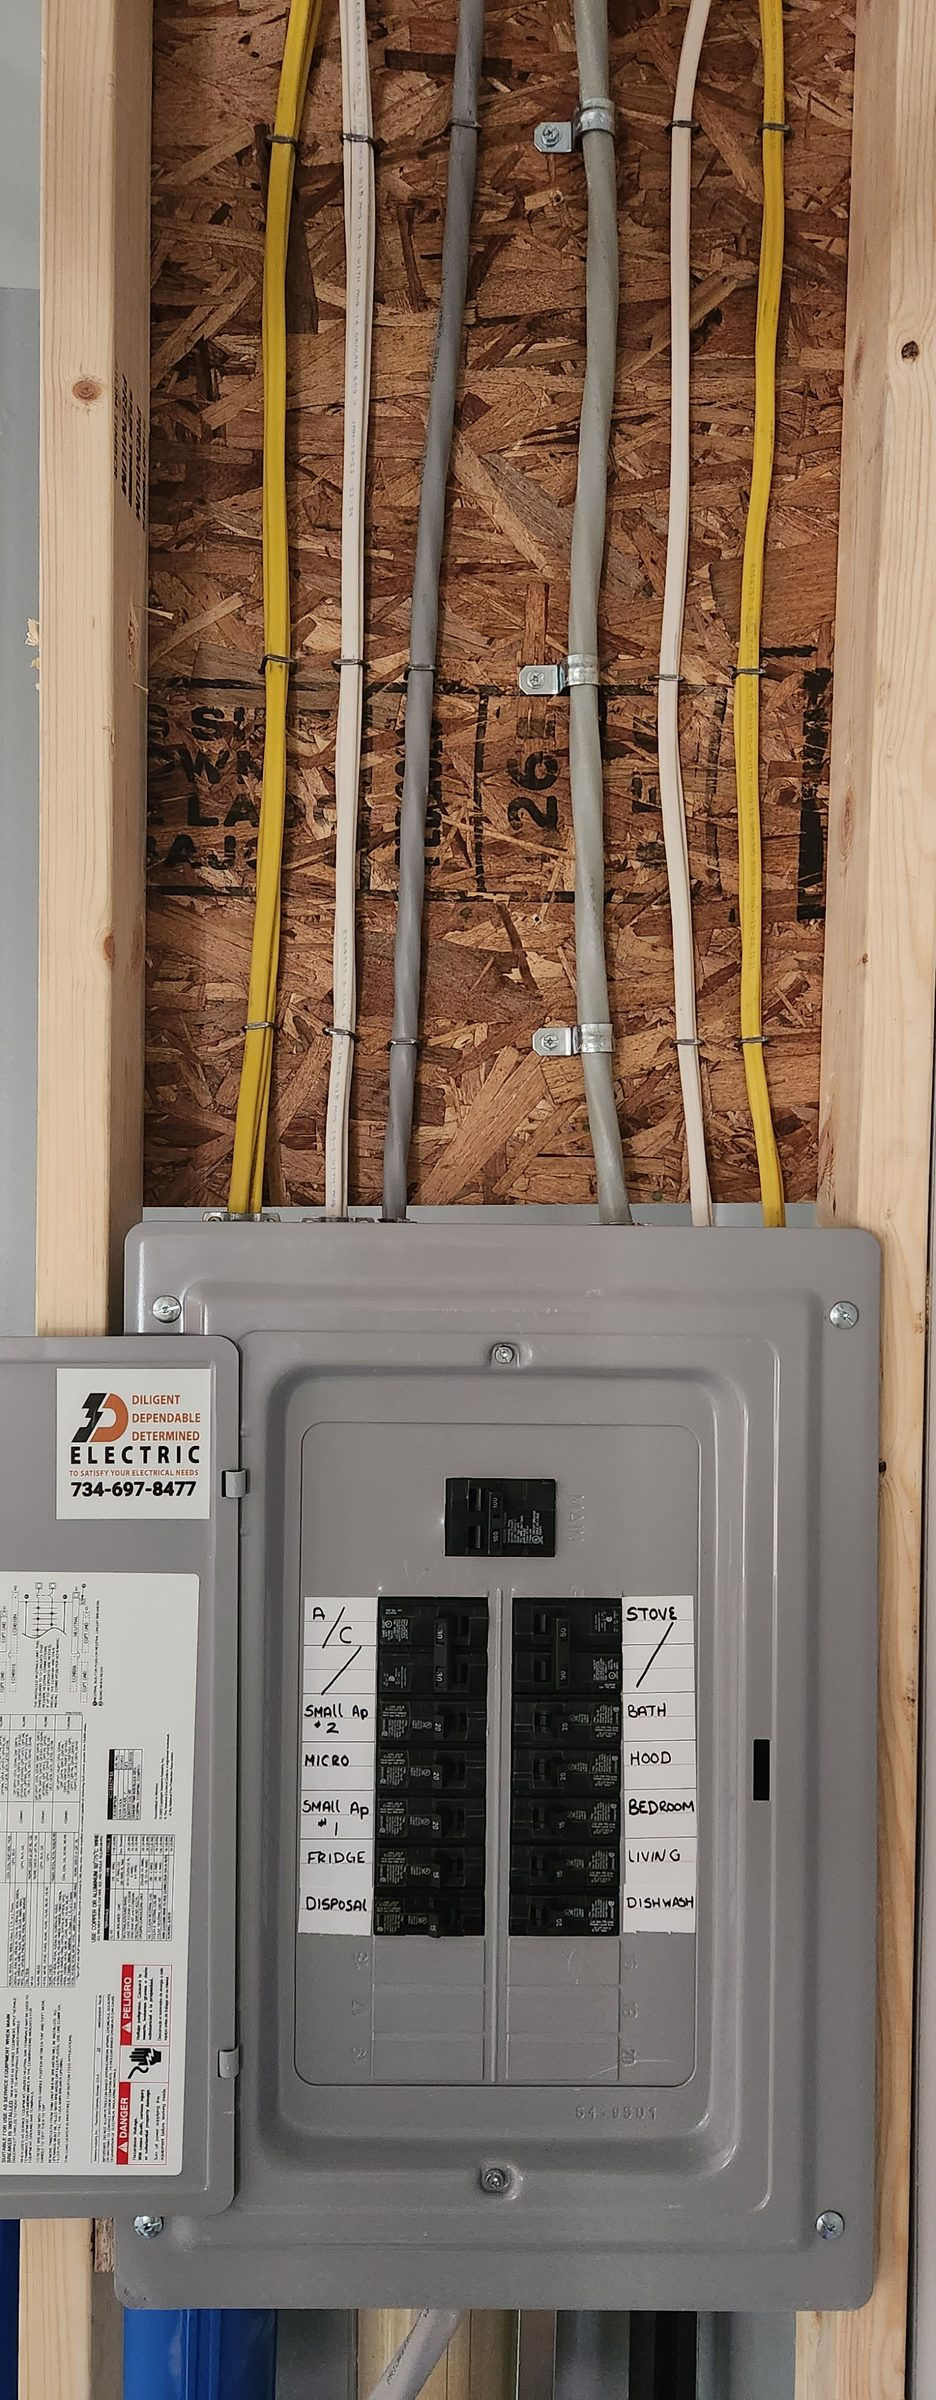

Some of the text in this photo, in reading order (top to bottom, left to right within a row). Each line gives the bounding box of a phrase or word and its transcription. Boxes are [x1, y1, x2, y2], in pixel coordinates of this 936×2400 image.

[131, 1394, 181, 1405] DILIGENT
[131, 1412, 201, 1423] DEPENDABLE
[131, 1431, 200, 1441] DETERMINED
[70, 1445, 200, 1464] ELECTRIC
[110, 1469, 130, 1477] YOUR
[70, 1481, 197, 1497] 734-697-8477
[626, 1607, 677, 1621] STOVE
[628, 1703, 666, 1718] BATH
[434, 1722, 441, 1732] 20
[561, 1722, 569, 1731] 20
[305, 1754, 349, 1766] MICRO
[631, 1751, 671, 1765] HOOD
[433, 1771, 440, 1781] 20
[559, 1772, 567, 1781] 20
[629, 1799, 694, 1815] BEDROOM
[432, 1820, 439, 1830] 20
[308, 1851, 365, 1864] FRIDGE
[629, 1849, 680, 1862] LIVING
[306, 1896, 367, 1912] DISPOSAL
[626, 1895, 694, 1909] DISHWASH
[123, 1977, 131, 2019] PELIGRO
[119, 2097, 128, 2138] DANGER
